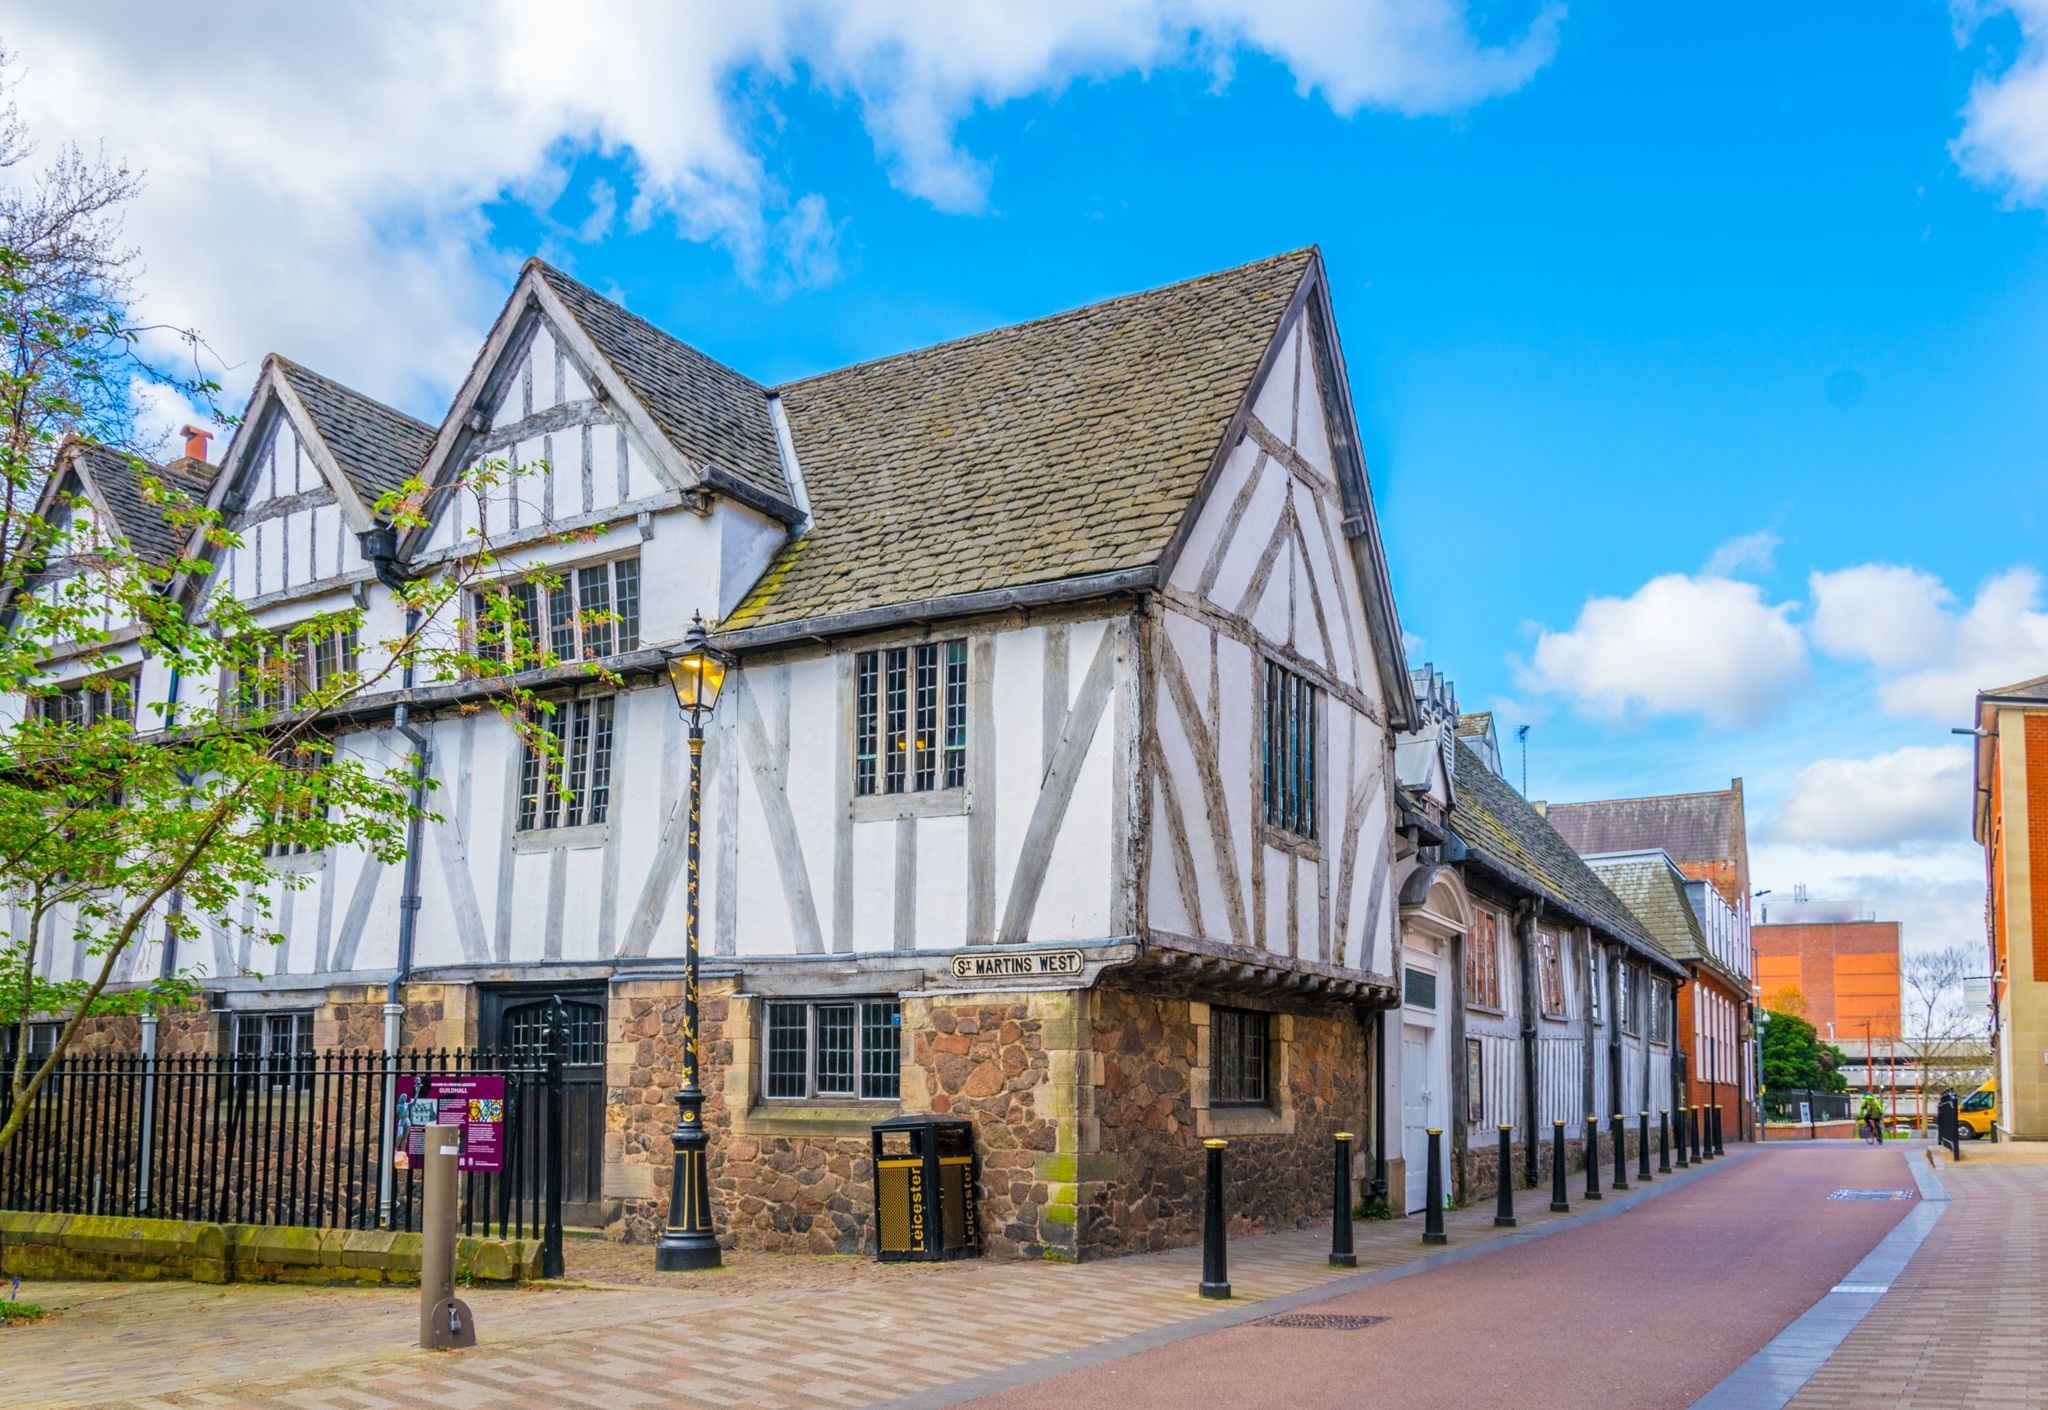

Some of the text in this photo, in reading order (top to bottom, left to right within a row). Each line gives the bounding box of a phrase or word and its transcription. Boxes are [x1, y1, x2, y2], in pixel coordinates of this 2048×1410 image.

[976, 957, 1032, 974] MARTINS
[1040, 955, 1075, 972] WEST
[911, 1167, 924, 1252] Leicester
[964, 1164, 975, 1247] Leicester
